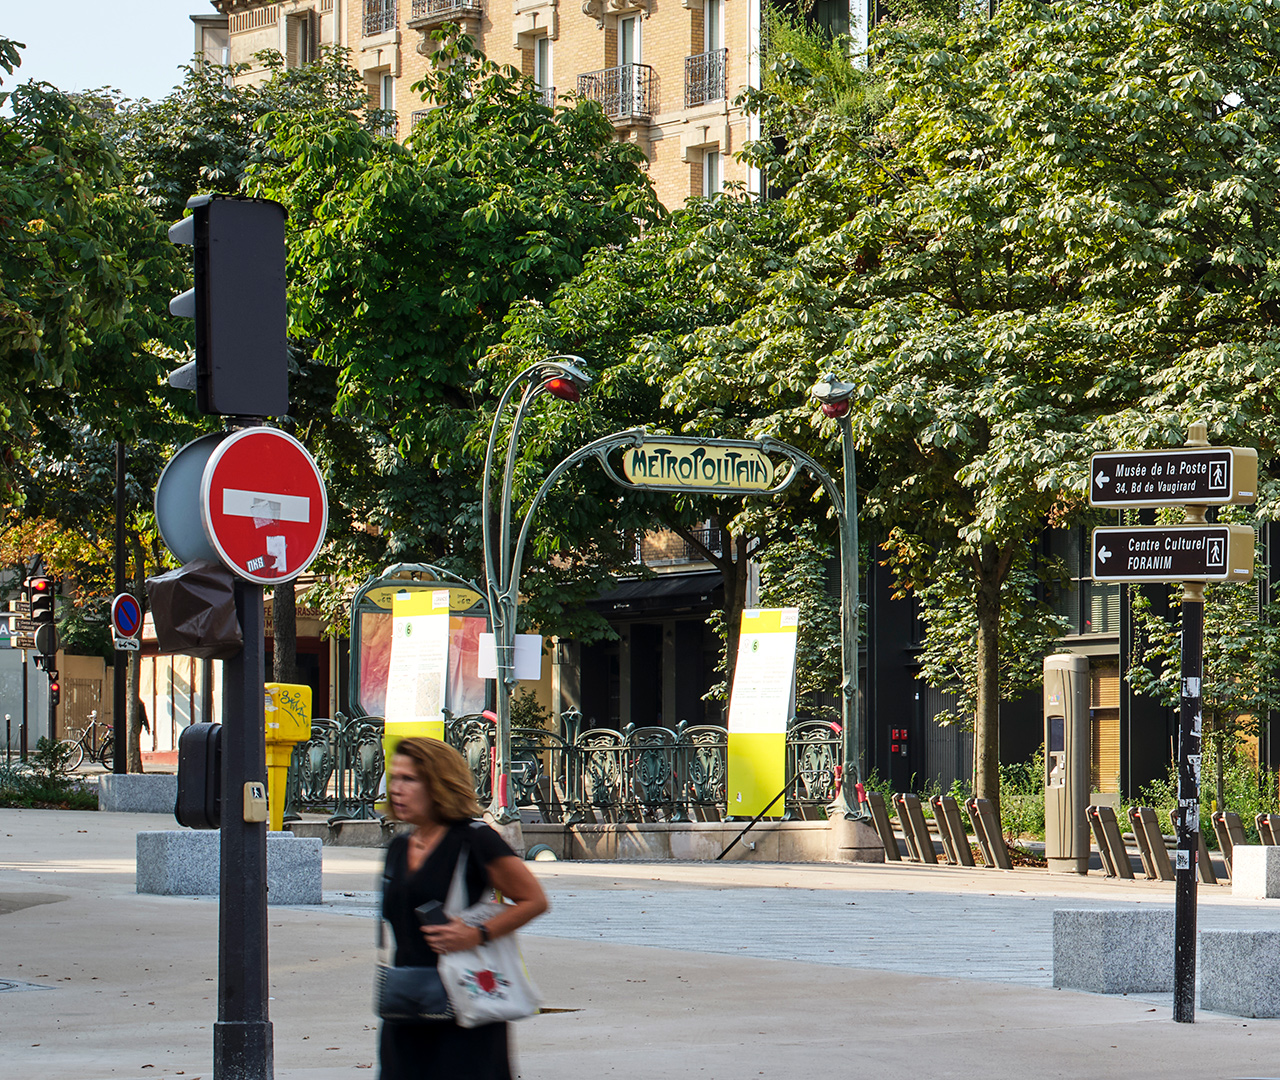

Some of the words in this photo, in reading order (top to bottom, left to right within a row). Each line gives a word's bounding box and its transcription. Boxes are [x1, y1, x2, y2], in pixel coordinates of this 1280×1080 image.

[632, 448, 768, 486] METROPOLITAIN
[1115, 462, 1147, 478] Musée
[1151, 462, 1162, 476] de
[1166, 461, 1175, 475] la
[1179, 461, 1207, 474] Poste
[1115, 482, 1128, 495] 34,
[1131, 482, 1141, 494] Bd
[1144, 481, 1154, 493] de
[1157, 480, 1197, 495] Vaugirard
[1128, 537, 1160, 552] Centre
[1164, 536, 1206, 551] Culturel
[1127, 556, 1173, 570] FORANIM
